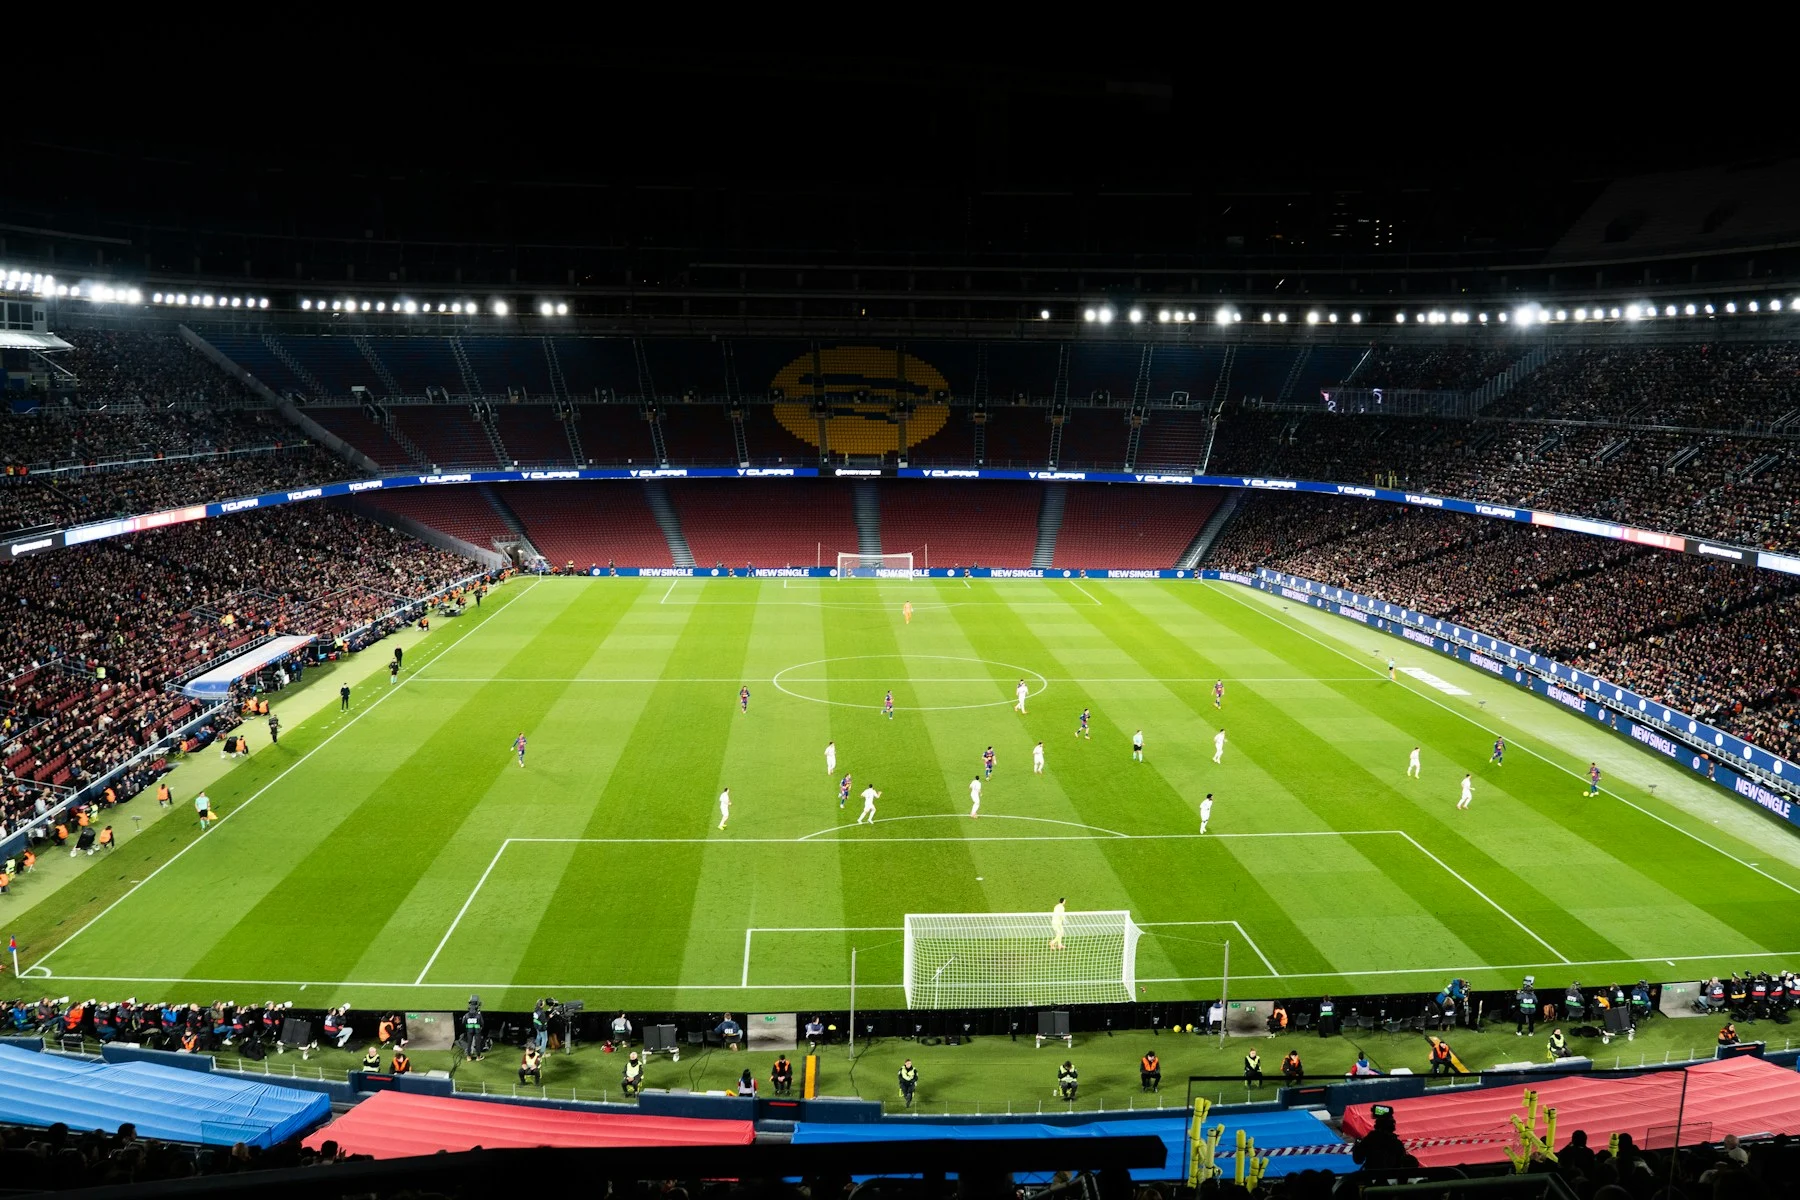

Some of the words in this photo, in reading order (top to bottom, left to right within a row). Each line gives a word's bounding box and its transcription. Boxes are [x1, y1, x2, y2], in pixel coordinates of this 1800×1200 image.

[639, 569, 661, 577] NEW
[661, 569, 693, 577] SINGLE
[756, 569, 777, 577] NEW
[777, 569, 809, 577] SINGLE
[1108, 570, 1129, 578] NEW
[1129, 570, 1160, 578] SINGLE
[1402, 628, 1416, 640] NEW
[1415, 632, 1434, 647] SINGLE
[1470, 653, 1484, 666] NEW
[1483, 657, 1503, 675] SINGLE
[1547, 685, 1562, 700] NEW
[1561, 692, 1586, 712] SINGLE
[1631, 725, 1651, 743] NEW
[1649, 734, 1677, 757] SINGLE
[1735, 777, 1759, 800] NEW
[1757, 788, 1791, 819] SINGLE
